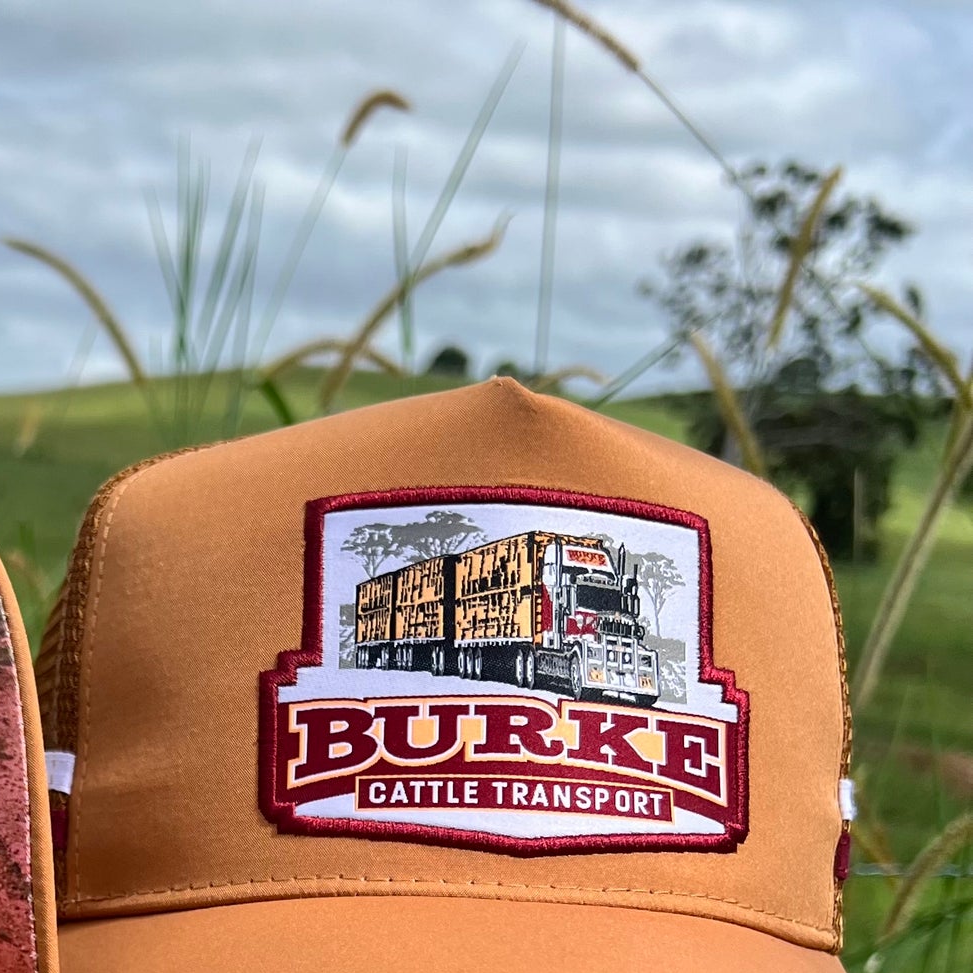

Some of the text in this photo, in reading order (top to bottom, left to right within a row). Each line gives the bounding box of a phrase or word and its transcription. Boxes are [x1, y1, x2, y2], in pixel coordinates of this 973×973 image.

[291, 702, 723, 801] BURKE
[368, 780, 663, 815] CATTLE TRANSPORT
